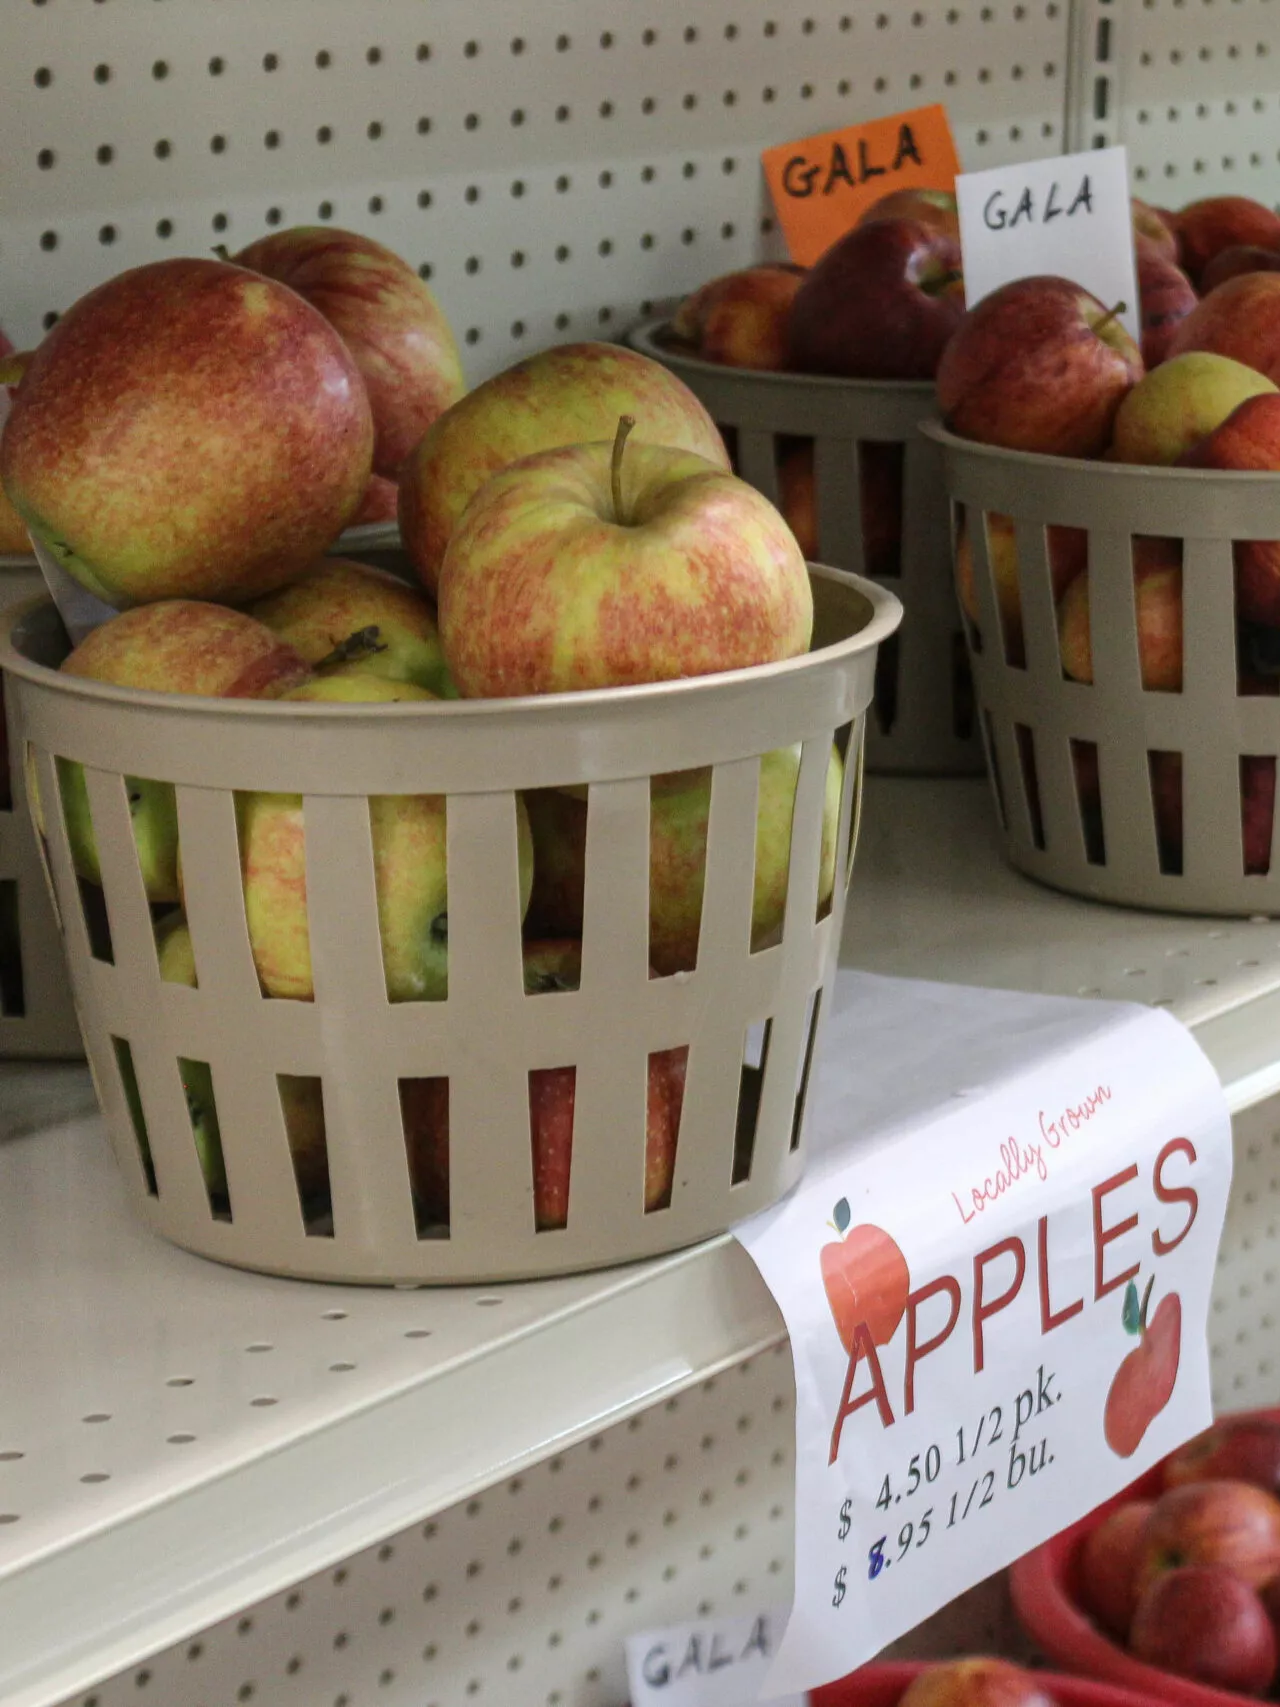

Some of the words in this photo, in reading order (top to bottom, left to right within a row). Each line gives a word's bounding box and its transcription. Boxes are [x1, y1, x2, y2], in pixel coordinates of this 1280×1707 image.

[783, 123, 923, 198] GALA
[983, 174, 1094, 232] GALA
[952, 1135, 1048, 1225] Locally
[1038, 1083, 1112, 1150] Grown
[827, 1136, 1200, 1467] APPLES
[875, 1443, 942, 1512] 4.50
[956, 1406, 1004, 1466] 1/2
[1010, 1363, 1063, 1444] pk.
[867, 1507, 934, 1581] 8.95
[947, 1470, 995, 1530] 1/2
[1006, 1437, 1055, 1490] bu.
[640, 1614, 773, 1689] GALA
